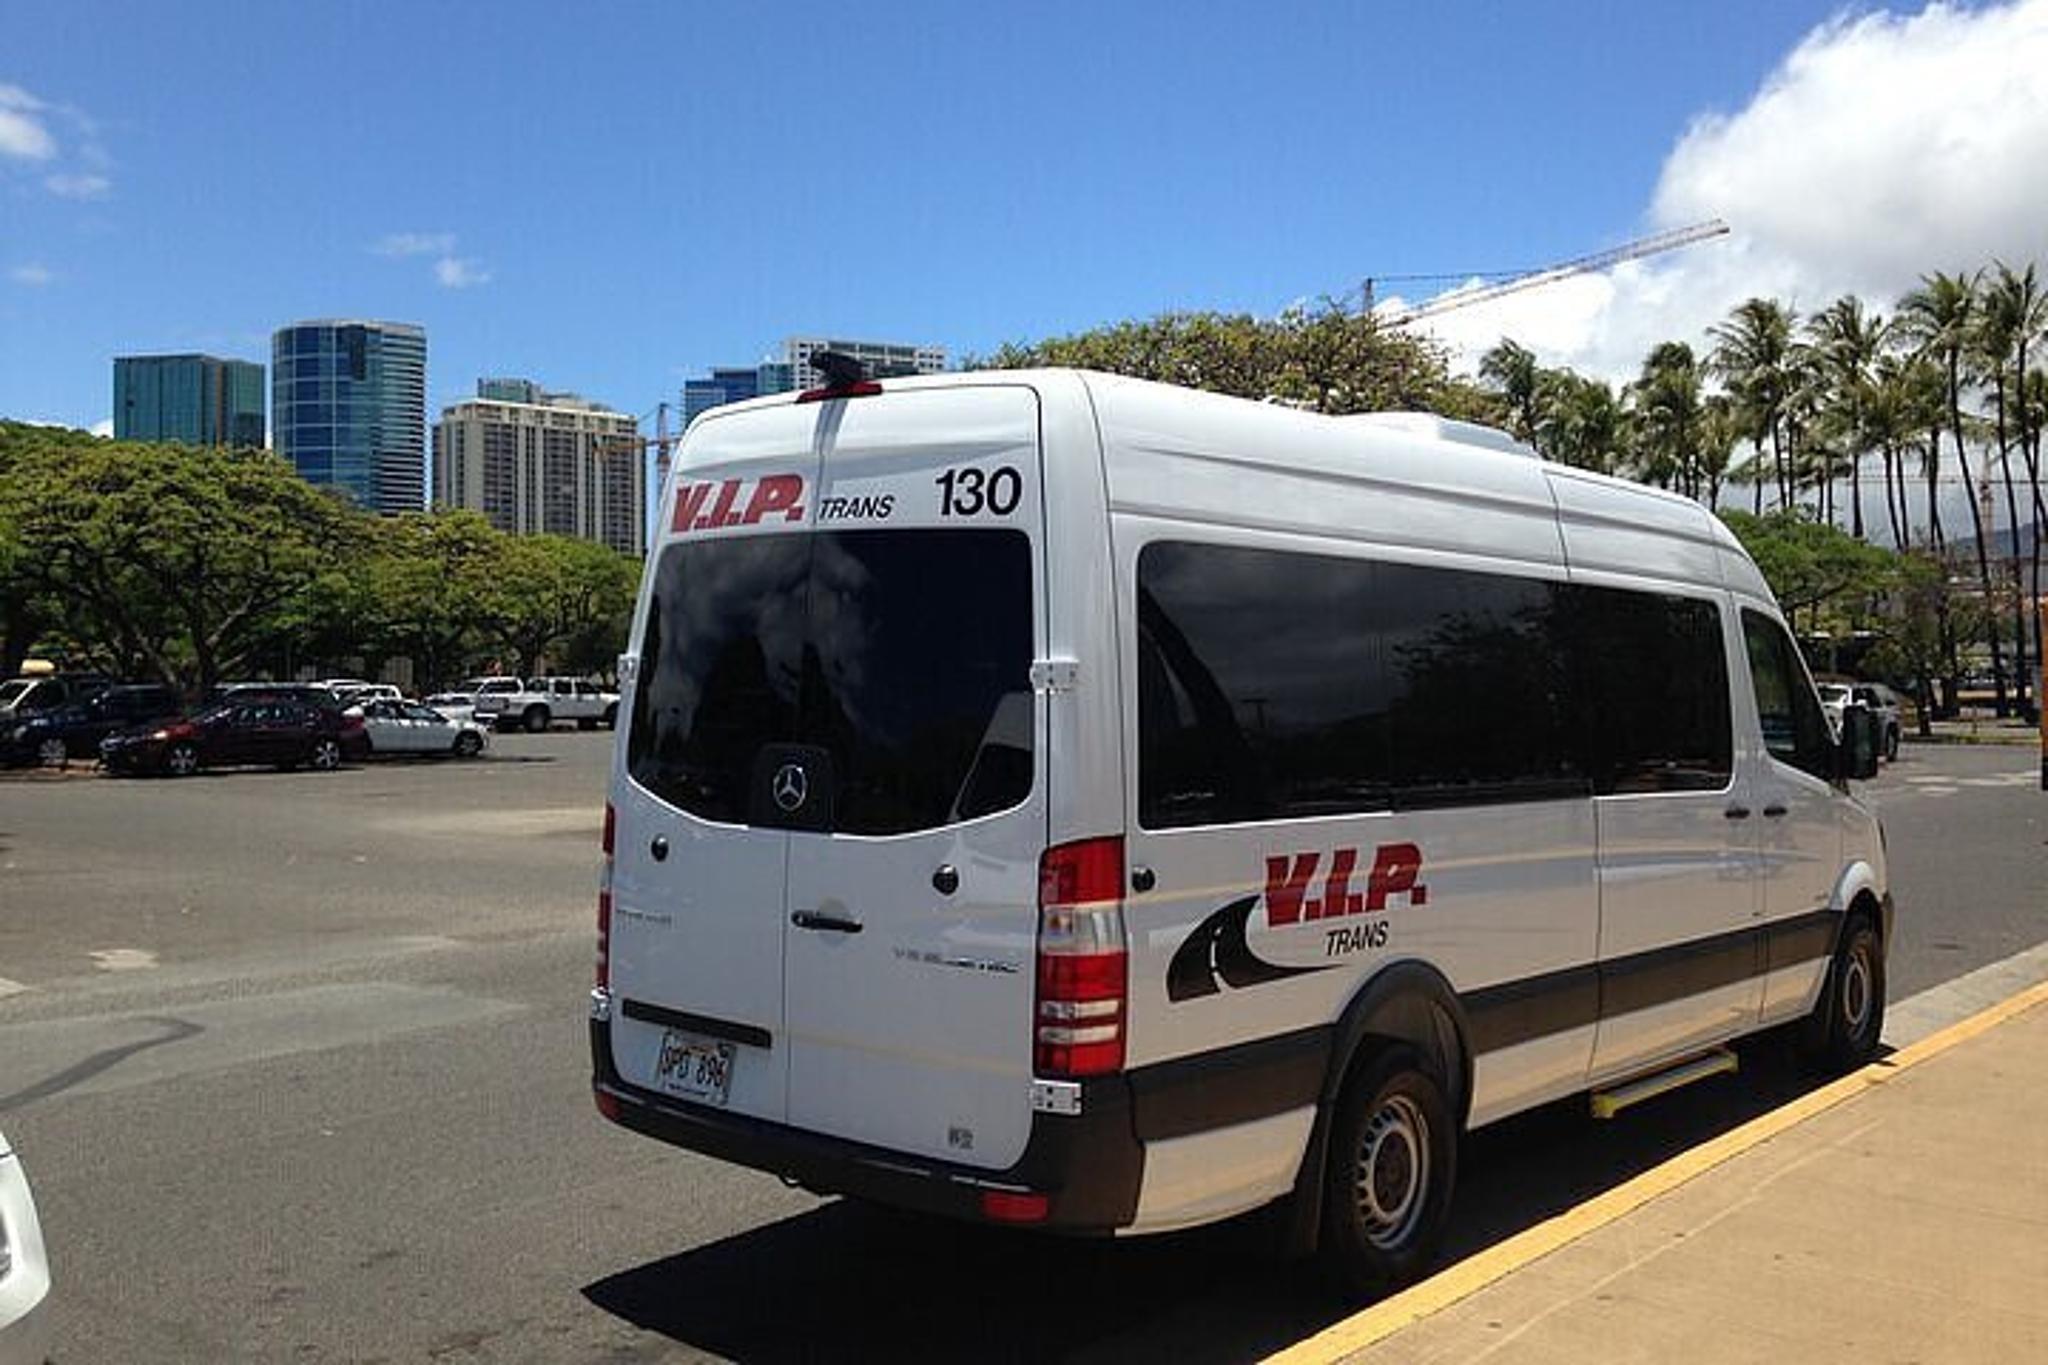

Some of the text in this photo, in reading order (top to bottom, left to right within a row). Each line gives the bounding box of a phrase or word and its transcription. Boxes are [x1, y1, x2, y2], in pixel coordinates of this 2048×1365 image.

[671, 473, 895, 532] V.I.P. TRANS
[935, 466, 1023, 516] 130
[1265, 842, 1427, 928] V.I.P.
[1325, 921, 1390, 956] TRANS
